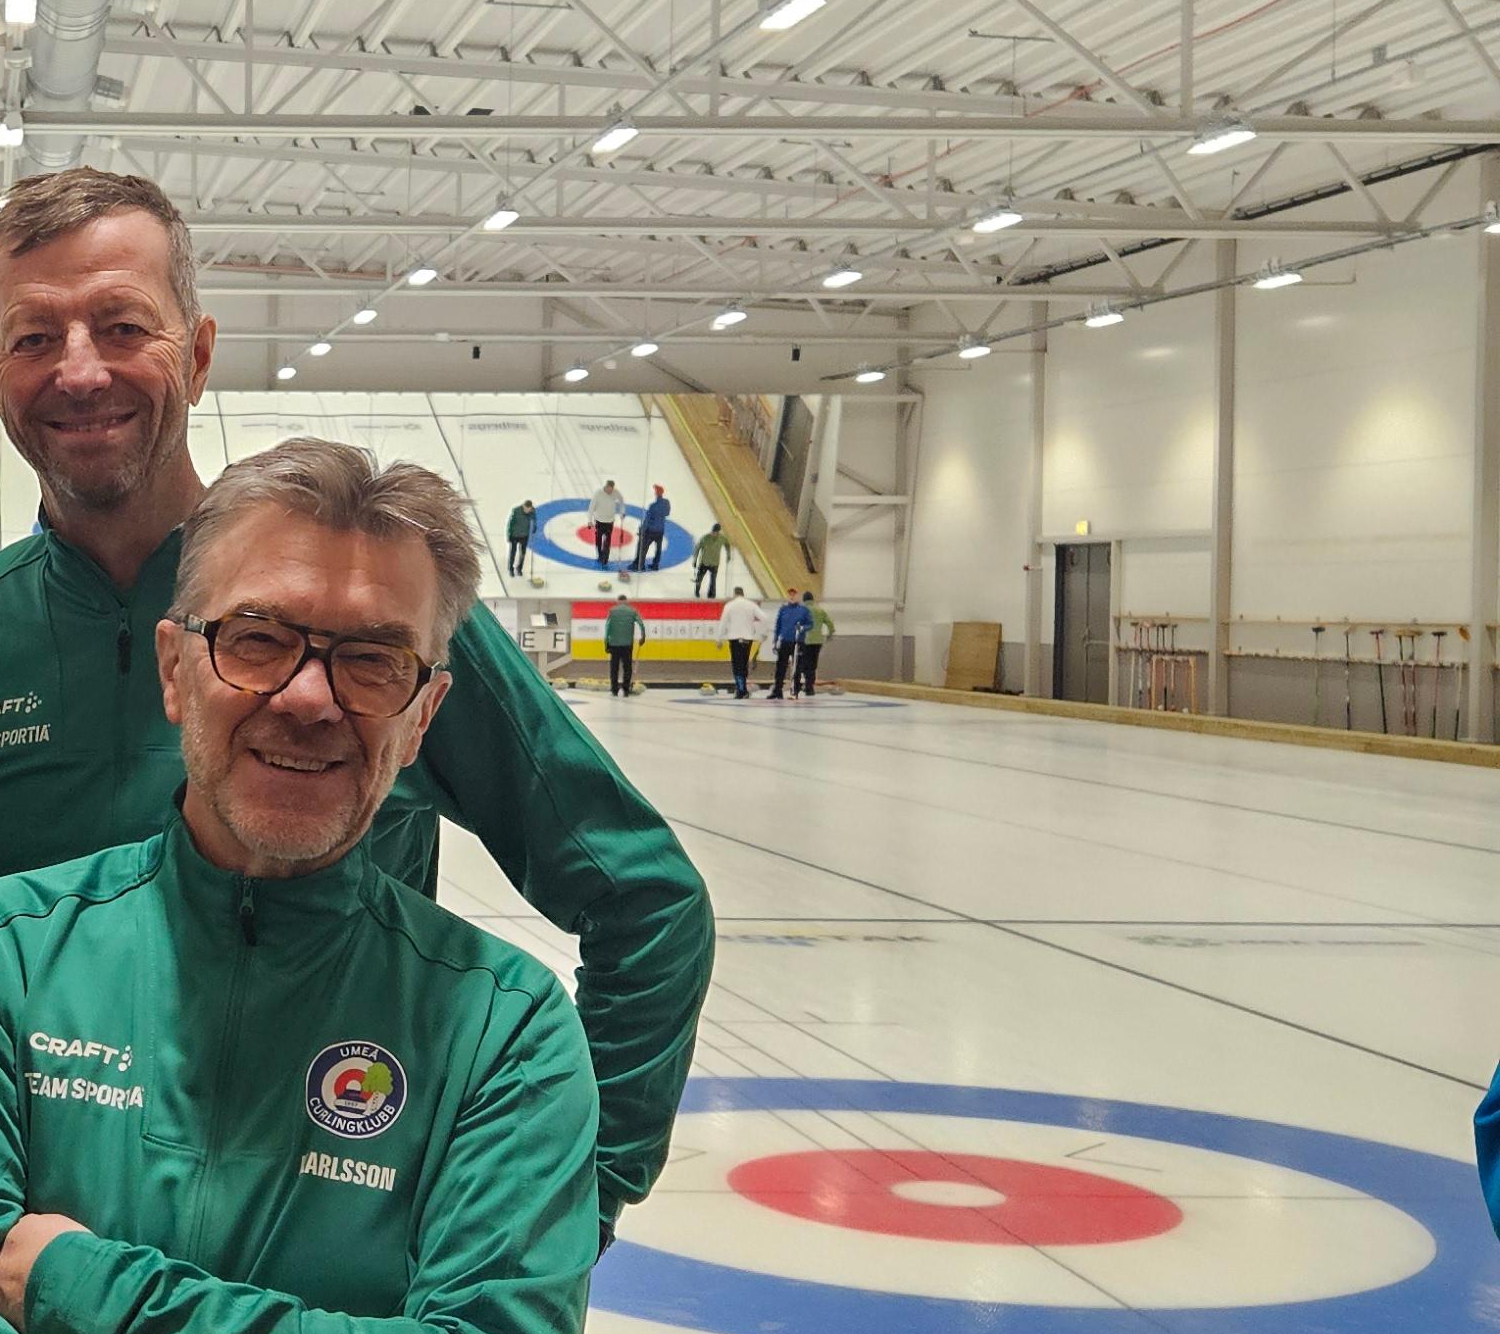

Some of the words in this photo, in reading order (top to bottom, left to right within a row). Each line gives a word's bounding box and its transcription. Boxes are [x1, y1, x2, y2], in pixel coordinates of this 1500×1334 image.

[522, 631, 535, 648] E
[553, 632, 565, 648] F
[29, 1032, 119, 1065] CRAFT
[339, 1044, 380, 1061] UMEÅ
[310, 1097, 396, 1133] CURLINGKLUBB
